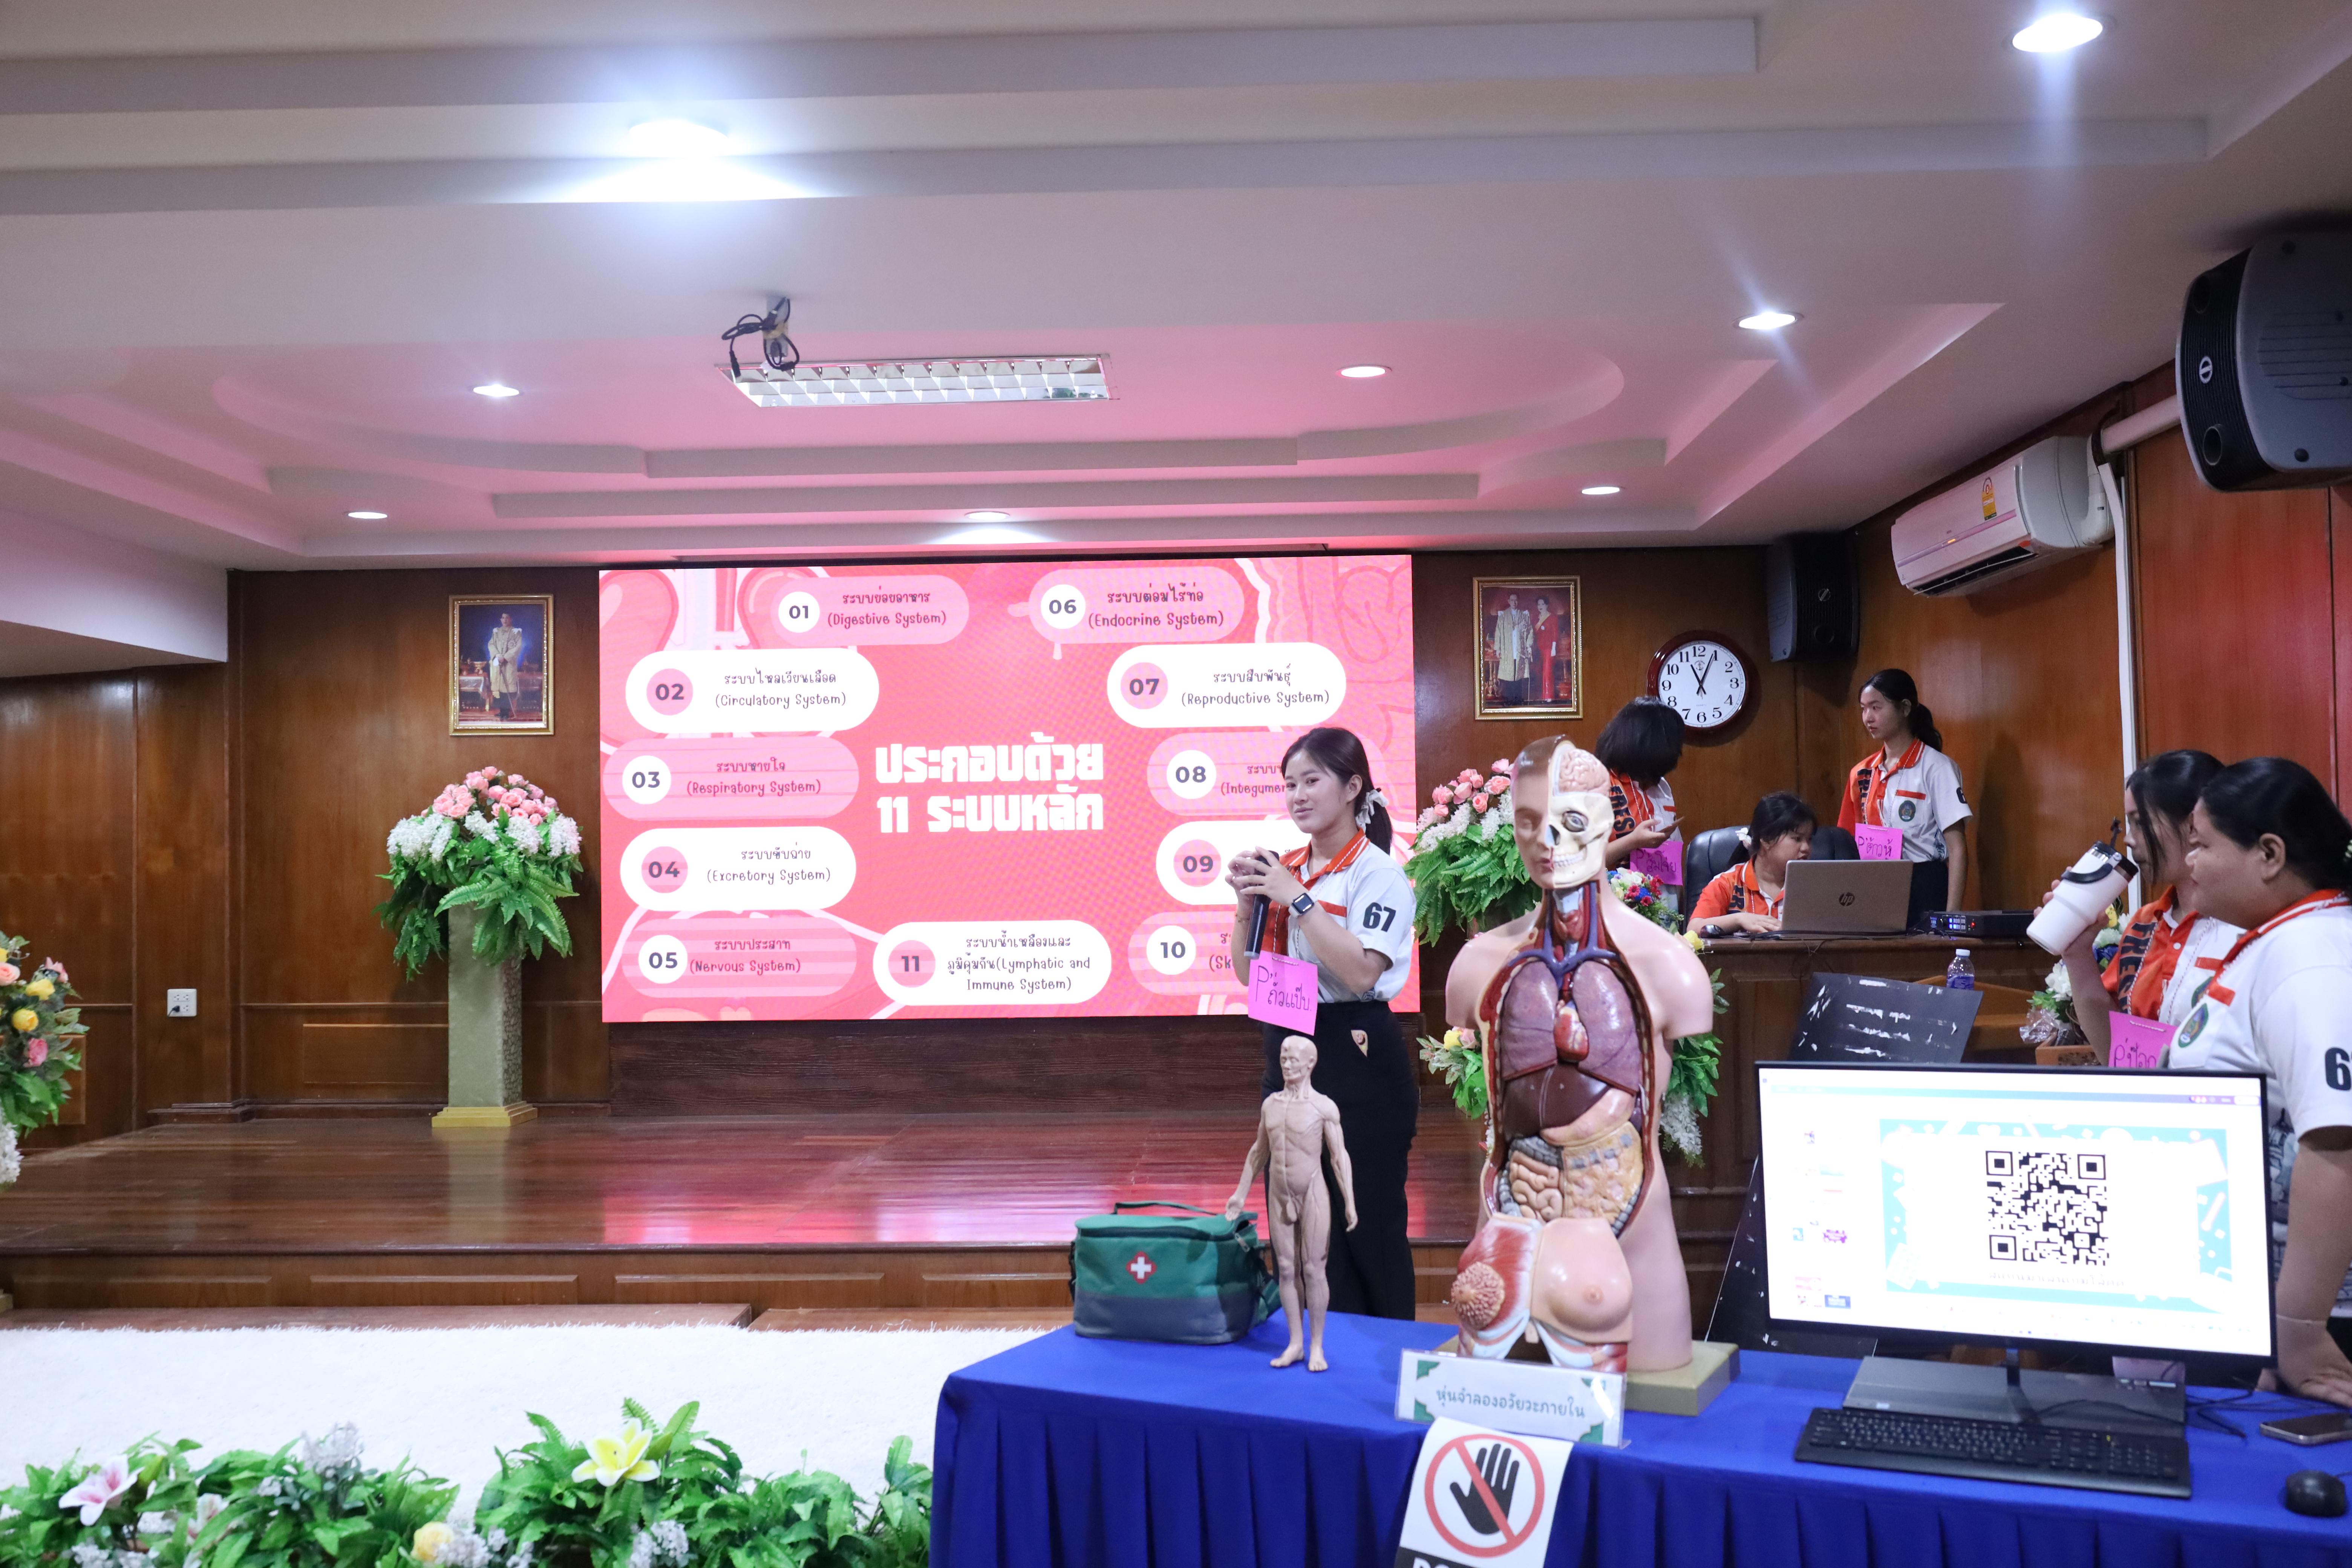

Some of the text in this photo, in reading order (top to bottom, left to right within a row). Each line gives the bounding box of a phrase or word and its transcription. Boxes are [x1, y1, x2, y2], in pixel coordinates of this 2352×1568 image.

[842, 586, 930, 604] ระบบย่อยอาหาร
[1107, 582, 1204, 603] ระบบต่อมไร้ท่อ
[789, 605, 810, 619] 01
[1049, 599, 1077, 614] 06
[828, 611, 946, 629] (Digestive System)
[1089, 611, 1224, 629] (Endocrine System)
[1678, 651, 1690, 663] 11
[1692, 646, 1706, 657] 12
[1714, 650, 1719, 661] 1
[1213, 663, 1291, 687] ระบบสืบพันธุ์
[1666, 663, 1679, 675] 10
[1725, 662, 1733, 672] 2
[724, 668, 836, 684] ระบบไหลเวียนเลือด
[1730, 678, 1739, 689] 3
[655, 684, 684, 700] 02
[1129, 678, 1160, 695] 07
[1661, 680, 1671, 691] 9
[715, 692, 846, 709] (Circulatory System)
[1182, 690, 1329, 708] (Reproductive System)
[1668, 696, 1677, 707] 8
[1724, 694, 1733, 706] 4
[1681, 709, 1691, 720] 7
[1697, 712, 1706, 723] 6
[1712, 707, 1722, 718] 5
[717, 757, 785, 772] ระบบหายใจ
[876, 732, 1103, 783] ประกอบด้วย
[632, 772, 660, 788] 03
[1175, 766, 1207, 783] 08
[687, 780, 821, 797] (Respiratory System)
[877, 784, 1103, 833] 11 ระบบหลัก
[741, 842, 811, 859] ระบบขับถ่าย
[649, 861, 680, 878] 04
[1183, 856, 1213, 872] 09
[707, 868, 830, 885] (Excretory System)
[1839, 892, 1855, 906] hp
[1363, 902, 1396, 932] 67
[715, 939, 790, 950] ระบบประสาท
[966, 930, 1071, 948] ระบบน้ำเหลืองและ
[1161, 942, 1185, 958] 10
[649, 952, 678, 969] 05
[690, 959, 801, 975] (Nervous System)
[901, 956, 920, 972] 11
[1070, 957, 1090, 969] and
[967, 977, 1072, 994] Immune System)
[2324, 1047, 2352, 1091] 6
[1436, 1385, 1585, 1419] หุ่นจำลองอวัยวะภายใน
